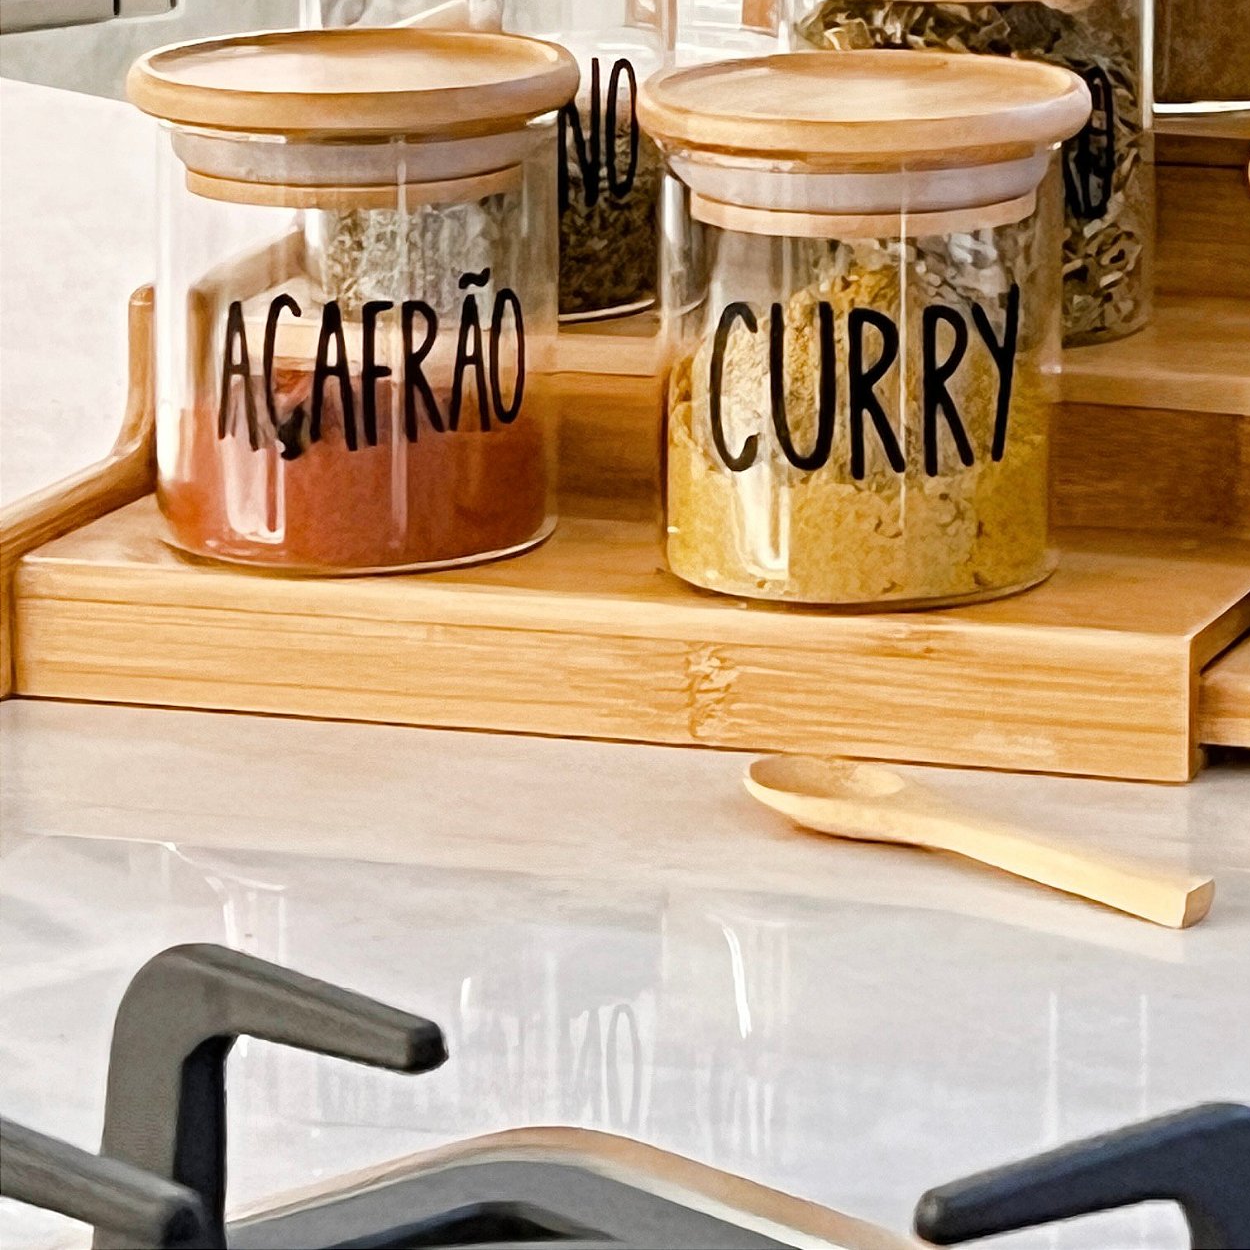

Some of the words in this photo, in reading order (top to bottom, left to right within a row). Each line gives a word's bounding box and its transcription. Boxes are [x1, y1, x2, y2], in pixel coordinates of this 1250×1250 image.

[1062, 67, 1116, 218] O
[218, 267, 526, 461] AÇAFRÃO
[710, 283, 1020, 480] CURRY
